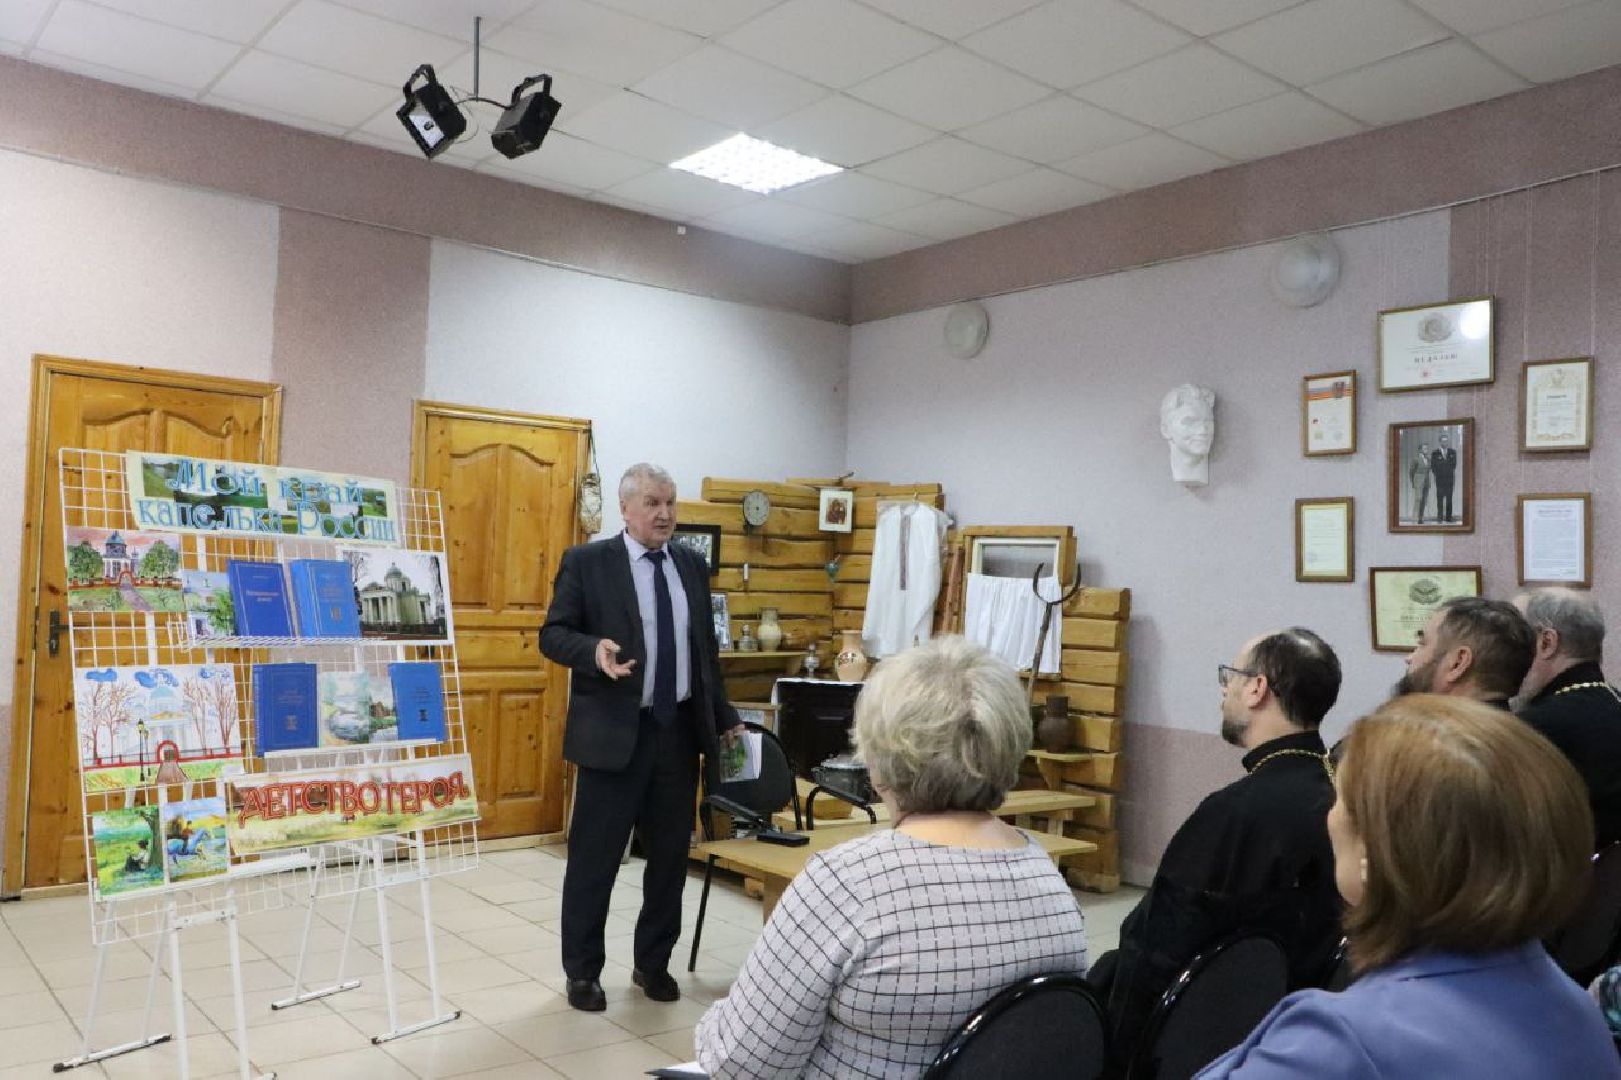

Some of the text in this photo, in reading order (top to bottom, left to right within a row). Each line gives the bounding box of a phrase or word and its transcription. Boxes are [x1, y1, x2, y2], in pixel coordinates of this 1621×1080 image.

[170, 457, 262, 497] Мой
[277, 477, 363, 507] край
[138, 498, 396, 541] капелька России
[239, 781, 381, 828] ДЕТСТВО
